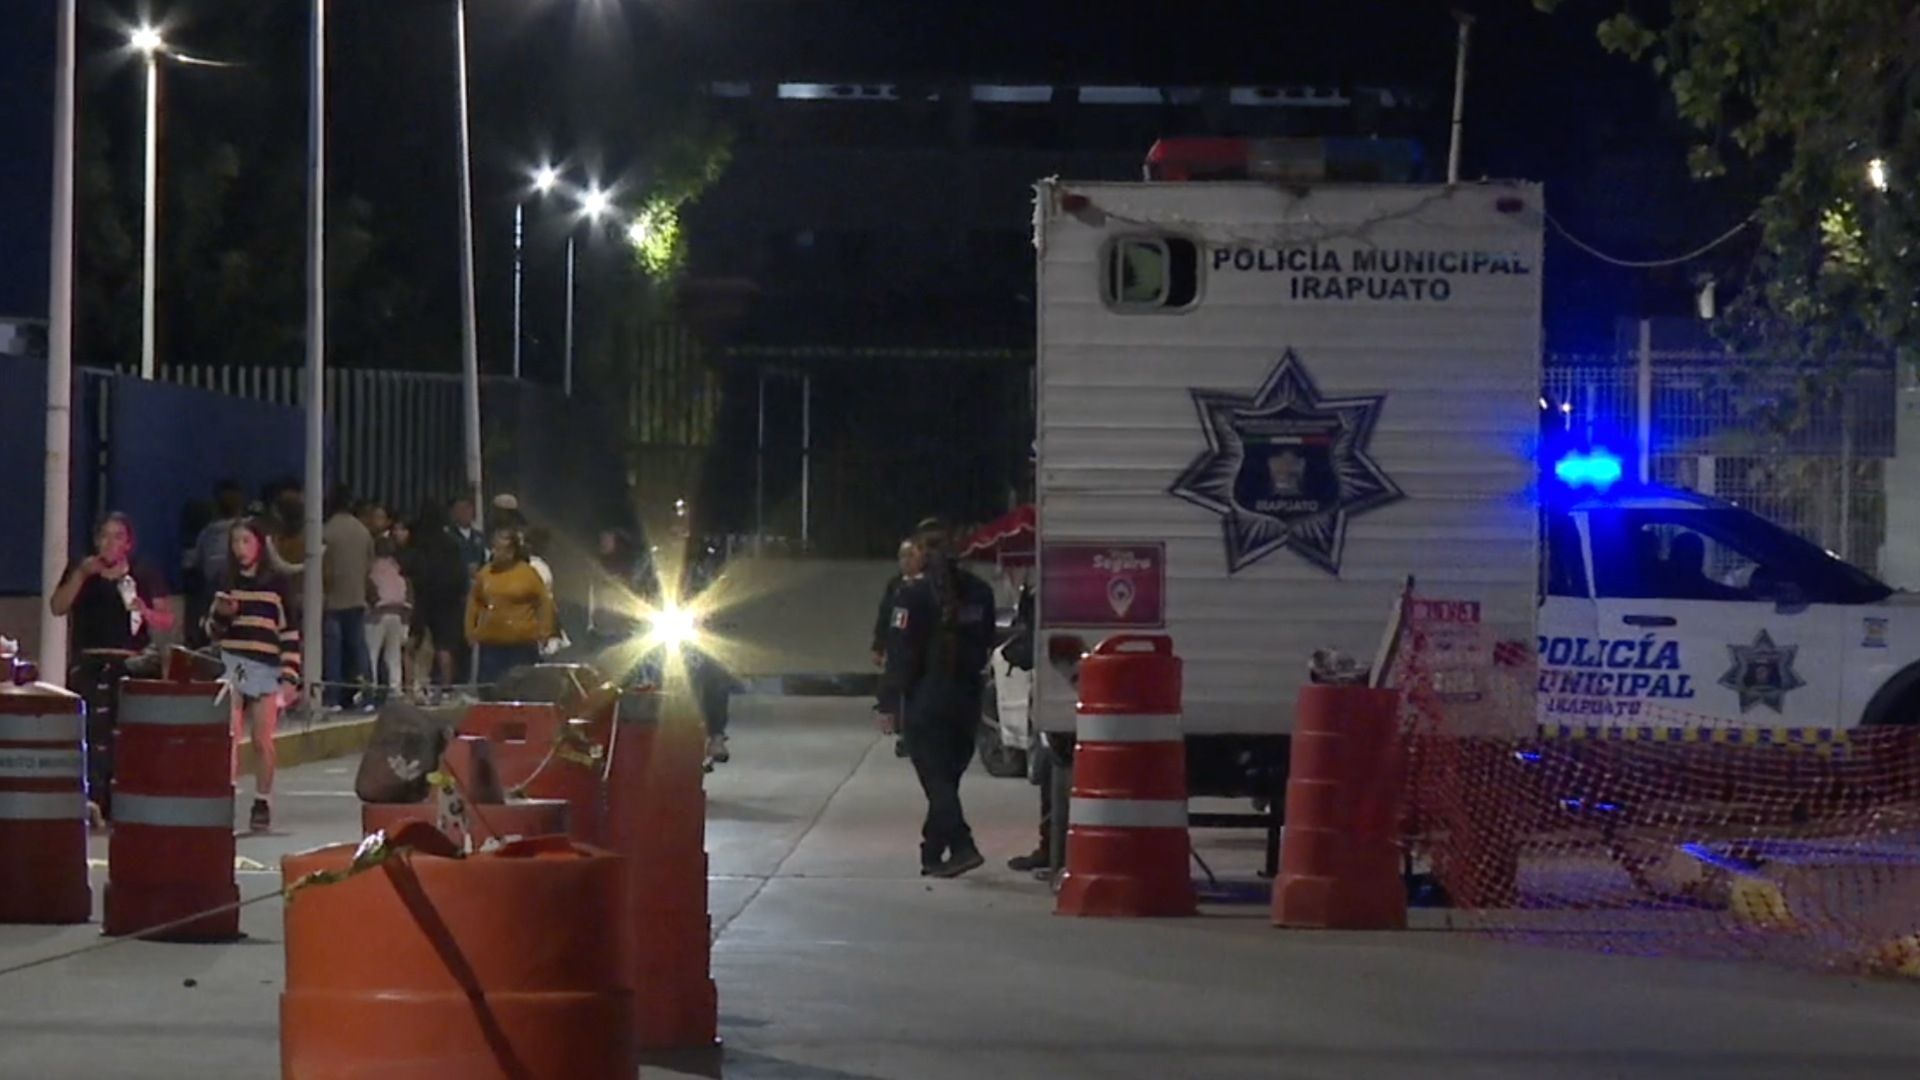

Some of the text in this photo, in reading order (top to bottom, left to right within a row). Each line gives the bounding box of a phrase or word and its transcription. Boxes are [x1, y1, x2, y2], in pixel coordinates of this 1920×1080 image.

[1352, 249, 1530, 275] MUNICIPAL
[1290, 276, 1451, 301] IRAPUATO
[1538, 669, 1695, 698] UNICIPAL
